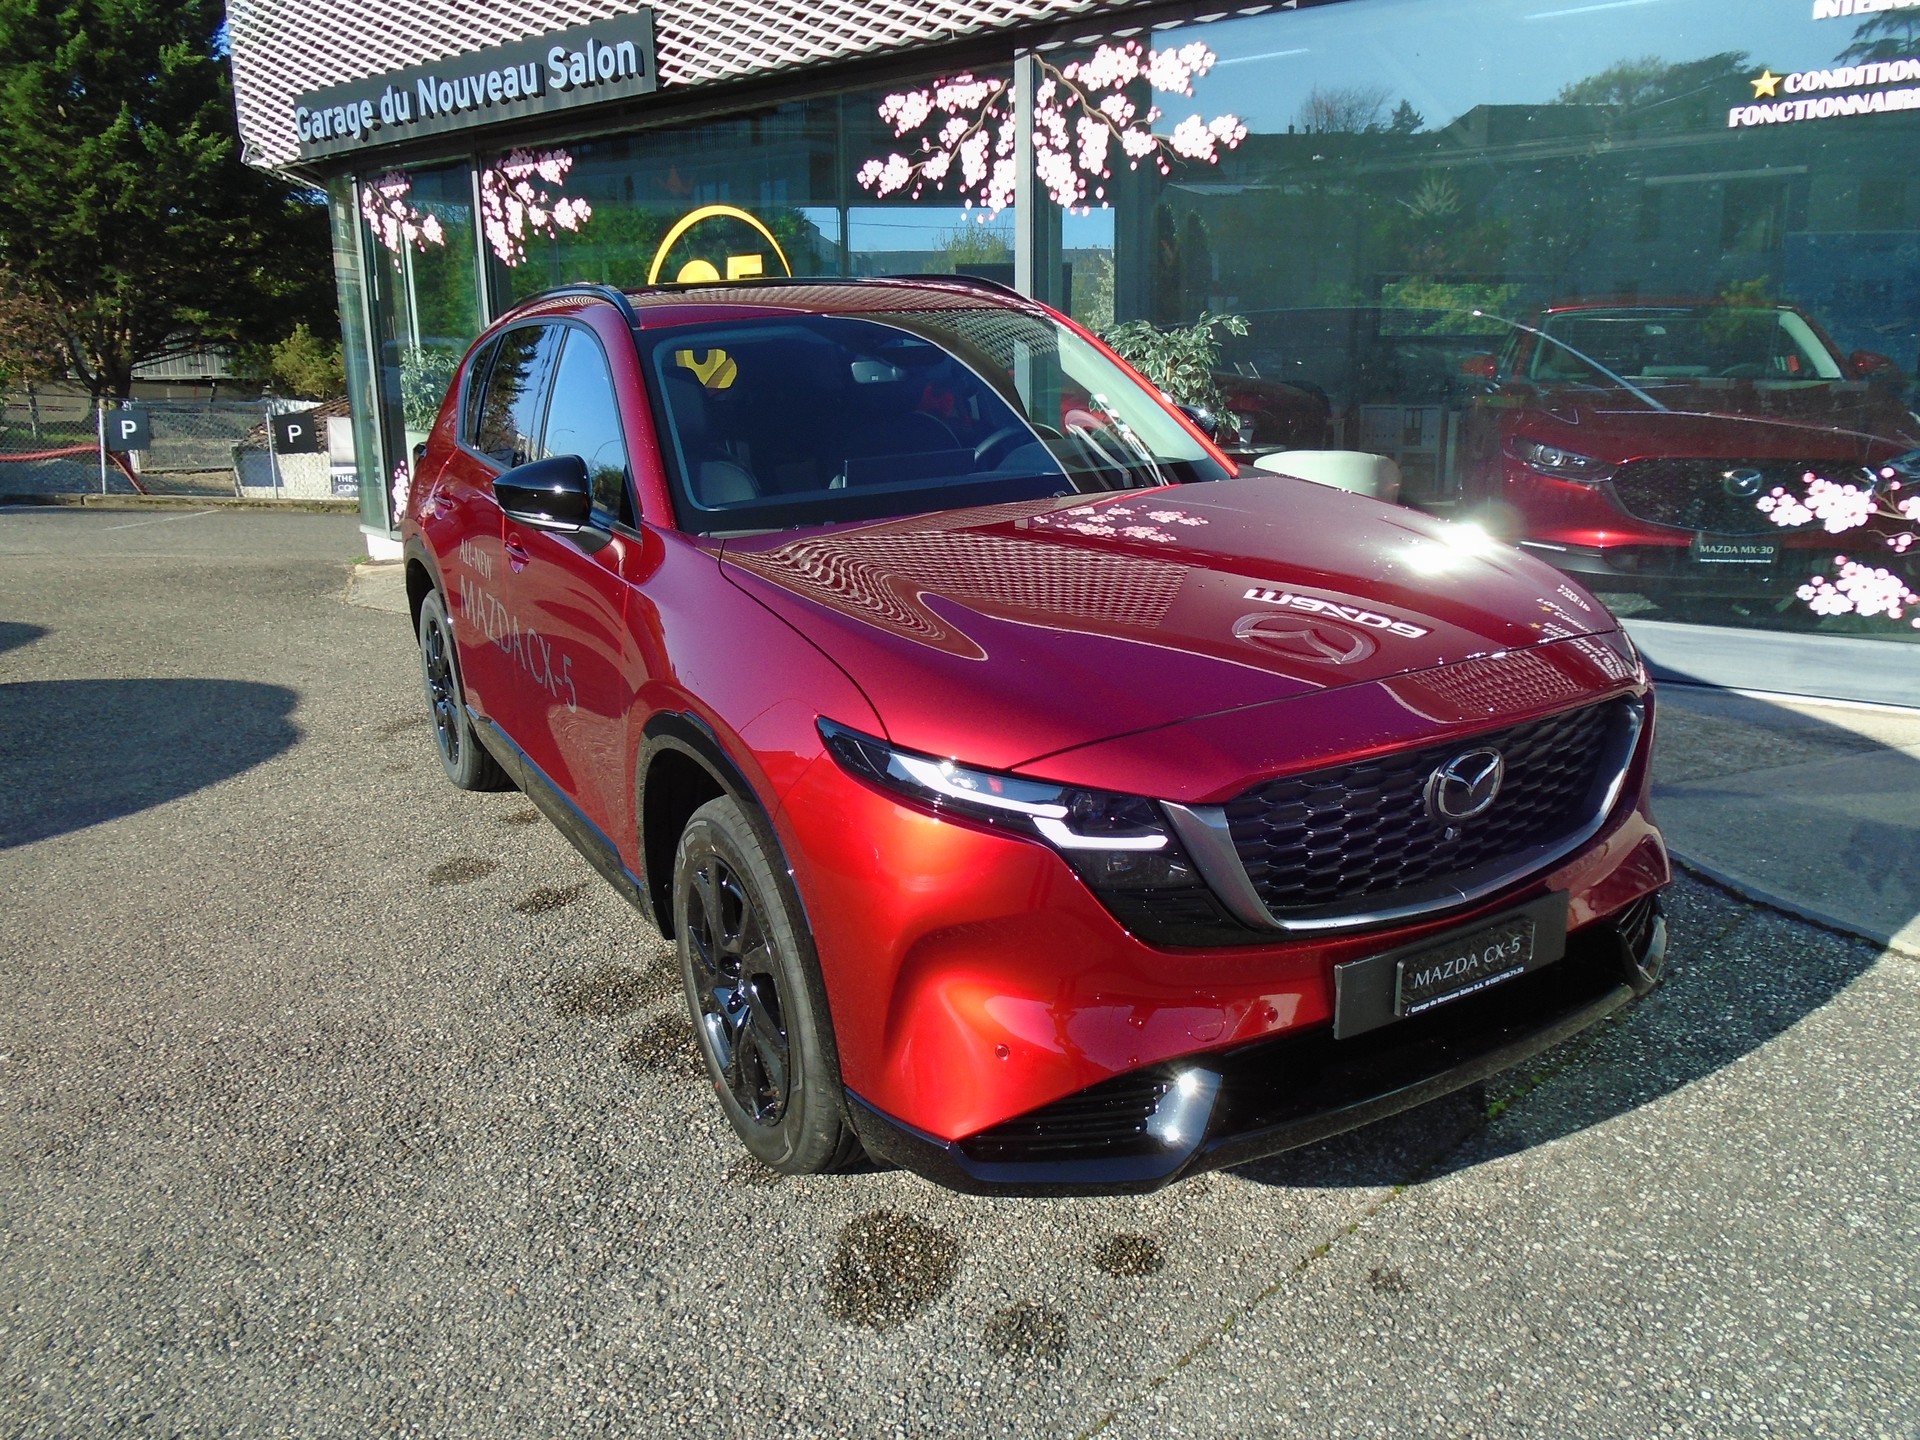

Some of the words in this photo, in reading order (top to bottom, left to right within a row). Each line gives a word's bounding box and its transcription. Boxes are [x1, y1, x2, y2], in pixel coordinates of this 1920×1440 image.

[295, 98, 373, 140] Garage
[380, 84, 411, 124] du
[417, 61, 538, 116] Nouveau
[547, 38, 637, 89] Salon
[121, 420, 137, 440] P
[287, 424, 301, 444] P
[337, 475, 354, 483] THE
[458, 538, 492, 581] ALL-NEW
[1700, 545, 1738, 554] MAZDA
[1741, 545, 1774, 554] MX-30
[460, 574, 527, 671] MAZDA
[527, 628, 577, 714] CX-5
[1414, 953, 1478, 989] MAZDA
[1483, 937, 1521, 963] CX-5
